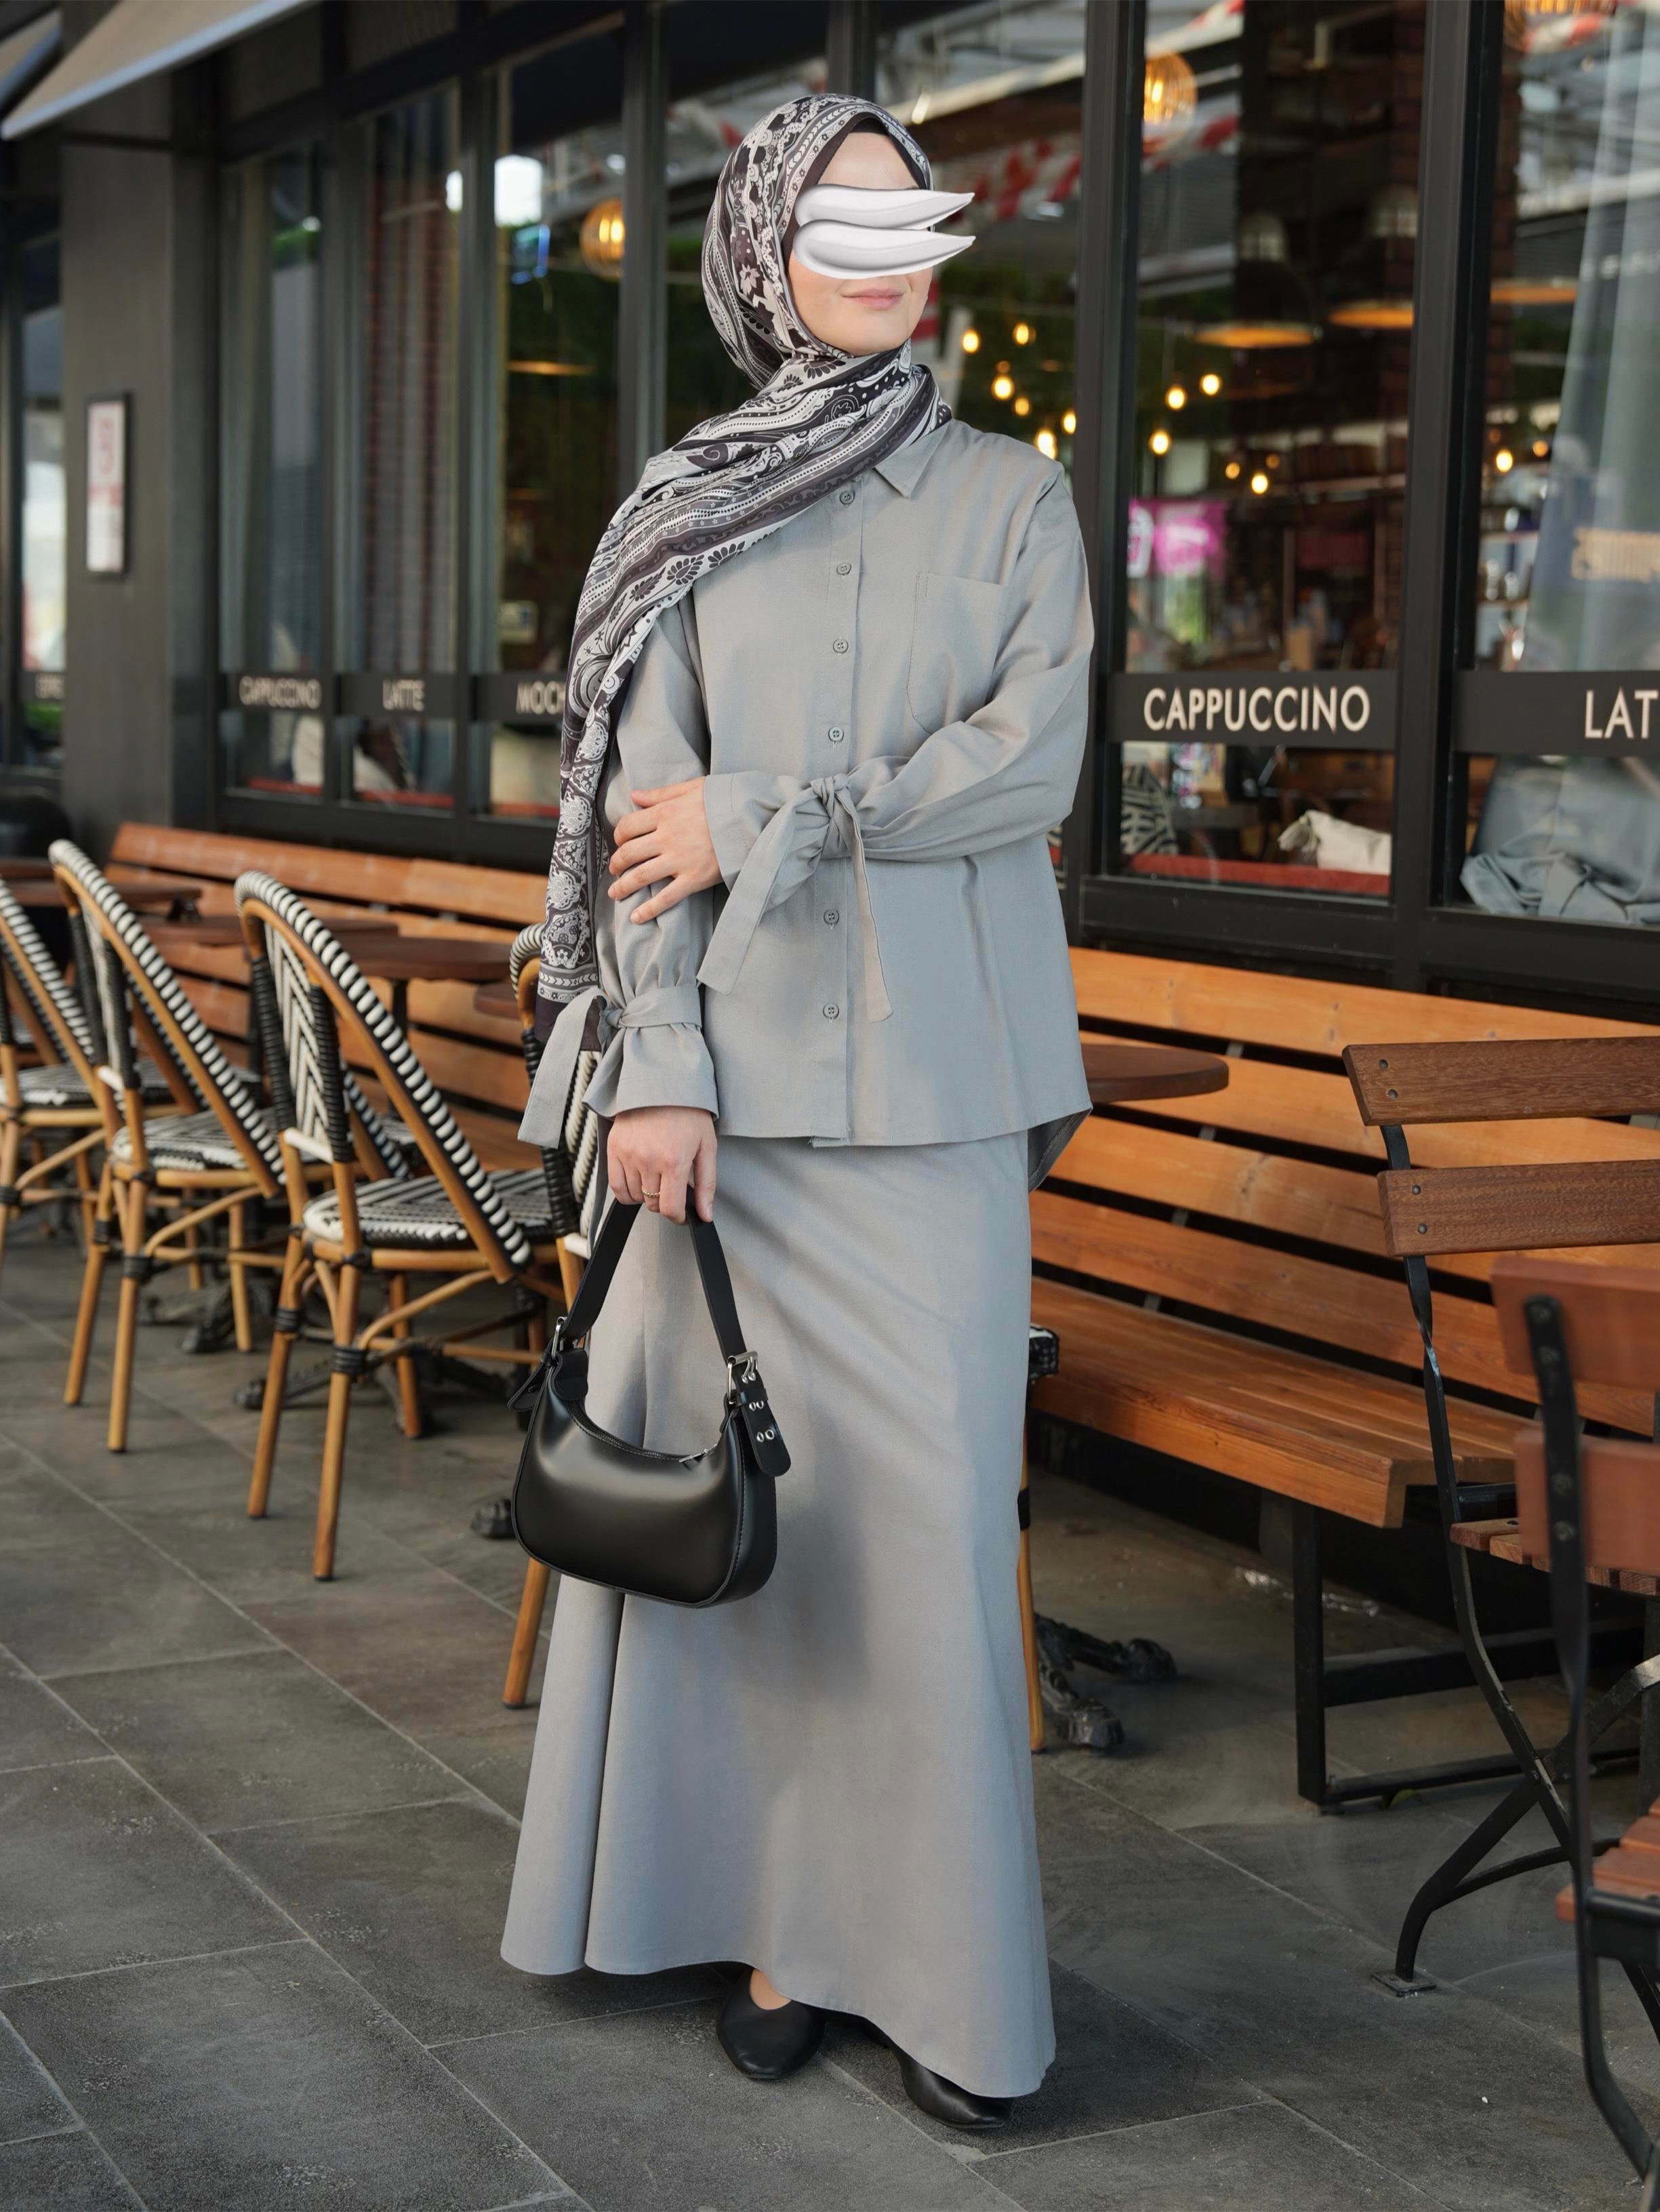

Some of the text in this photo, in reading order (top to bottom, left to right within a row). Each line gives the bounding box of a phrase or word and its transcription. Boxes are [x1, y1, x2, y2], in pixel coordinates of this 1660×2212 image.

[239, 677, 321, 708] CAPPUCCINO
[383, 679, 424, 711] LATTE
[1143, 685, 1370, 733] CAPPUCCINO
[1585, 686, 1659, 740] LAT
